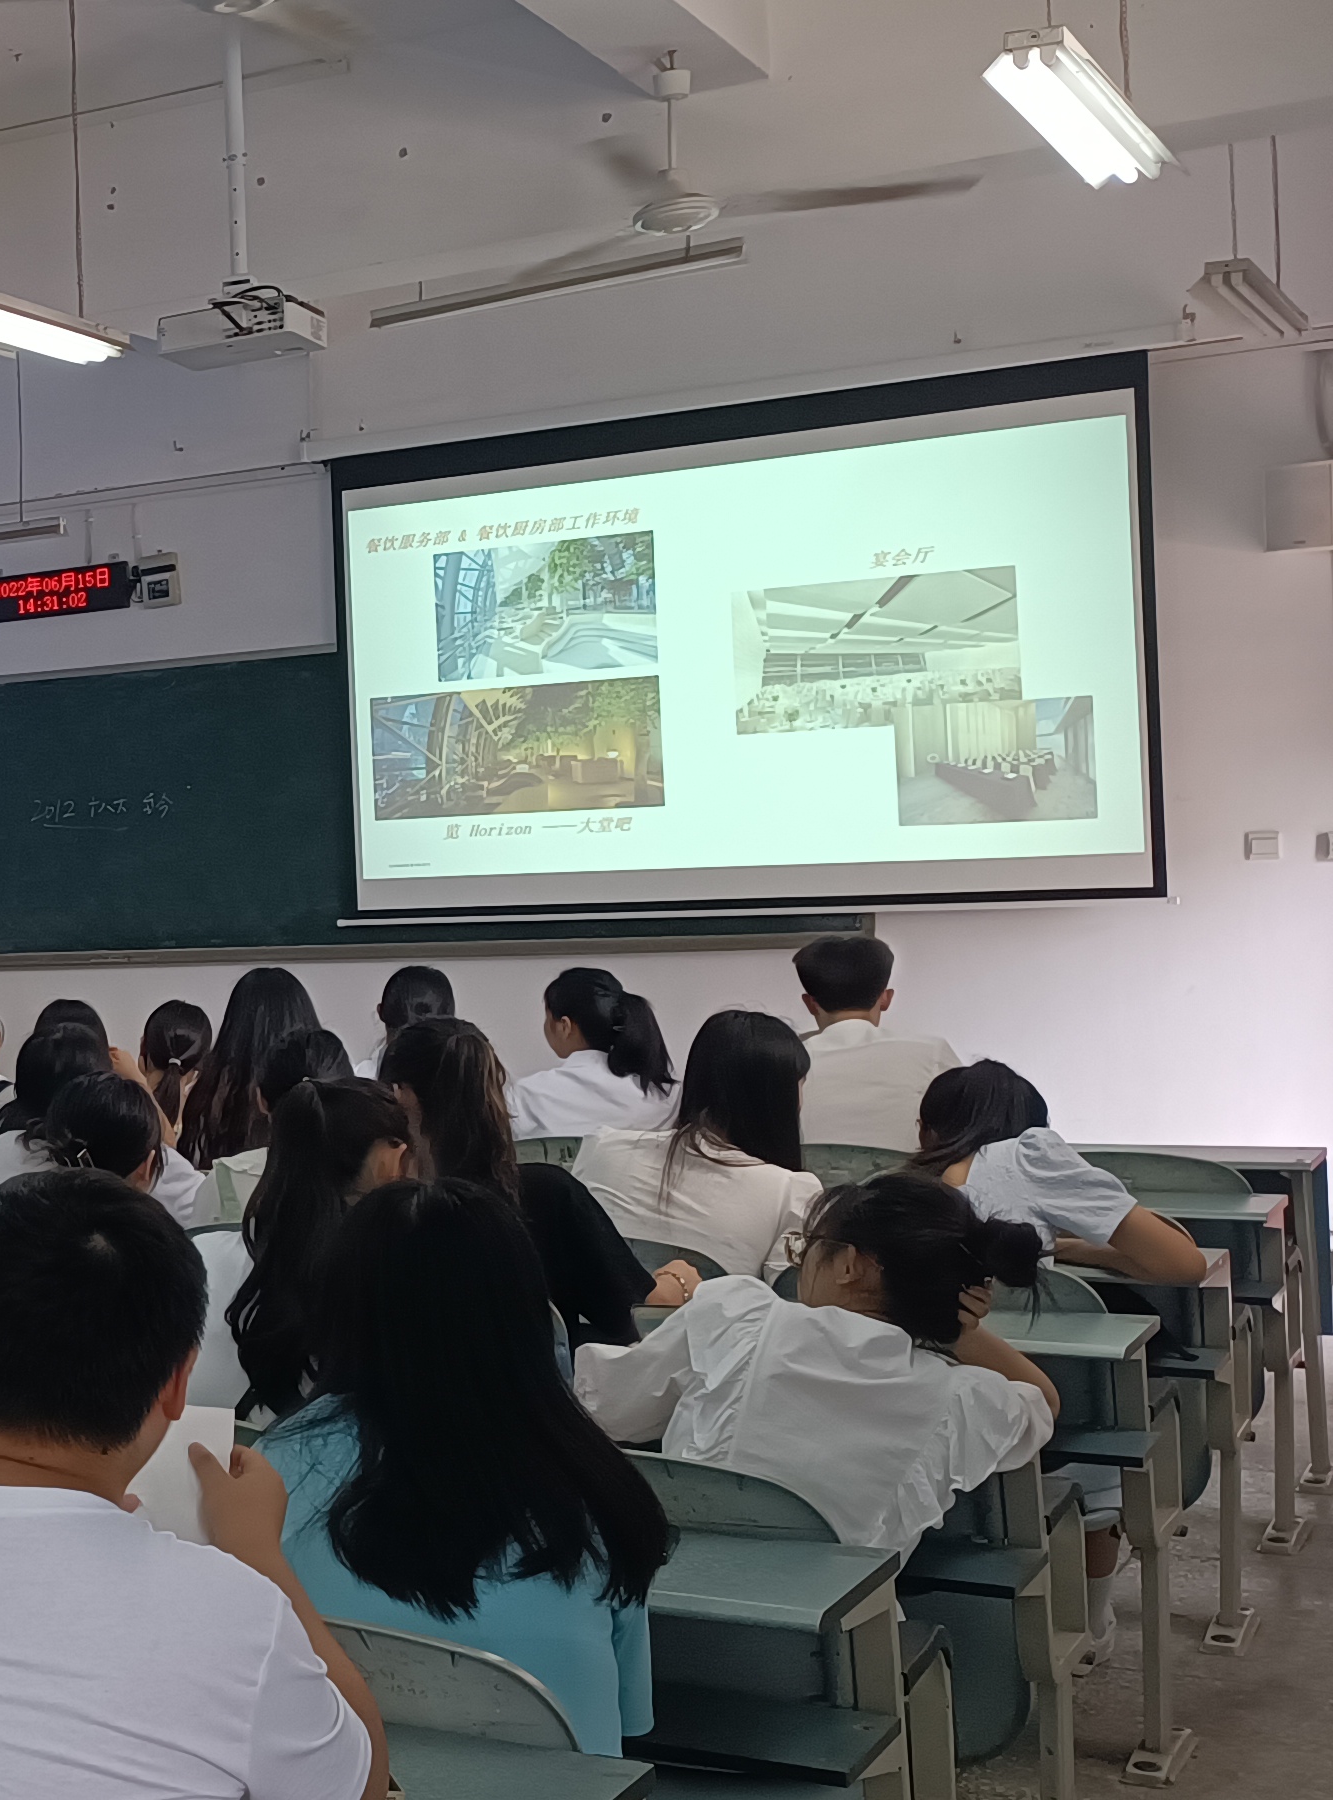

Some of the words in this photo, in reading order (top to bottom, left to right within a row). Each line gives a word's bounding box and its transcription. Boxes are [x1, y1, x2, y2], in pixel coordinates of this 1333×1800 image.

[366, 530, 452, 554] 餐饮服务部
[457, 529, 468, 543] &
[477, 507, 640, 542] 餐饮厨房部工作环境
[869, 545, 935, 569] 宴会厅
[17, 592, 87, 614] 14:31:02
[469, 823, 533, 838] Horizon
